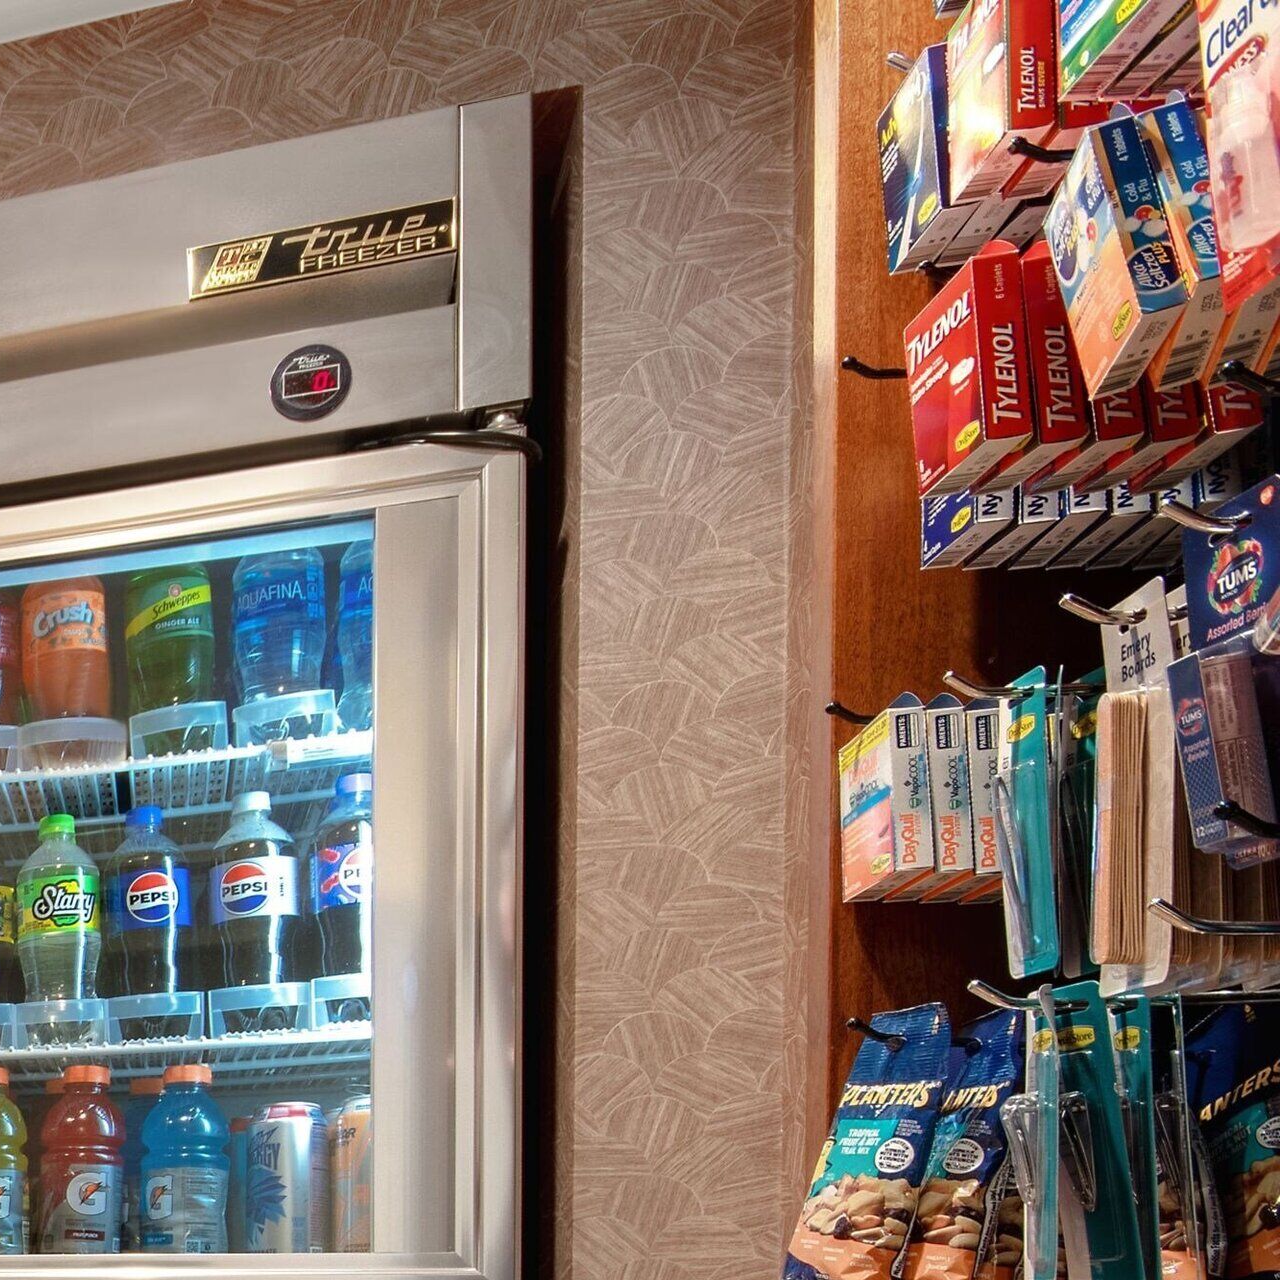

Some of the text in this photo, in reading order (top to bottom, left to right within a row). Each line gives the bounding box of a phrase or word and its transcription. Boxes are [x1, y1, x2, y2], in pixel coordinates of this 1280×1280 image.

[1018, 46, 1035, 113] TYLENOL
[300, 236, 437, 274] FREEZER
[907, 289, 971, 376] TYLENOL
[992, 323, 1022, 424] TYLENOL
[1044, 325, 1077, 429] TYLENOL
[1217, 562, 1259, 595] TUMS
[32, 602, 94, 638] Crush
[151, 590, 201, 618] Schweppes
[155, 617, 202, 630] GINGER ALE
[1205, 613, 1245, 642] Assorted
[1121, 632, 1151, 663] Emery
[899, 811, 916, 864] DayQuil
[939, 814, 957, 866] DayQuil
[979, 816, 996, 868] DayQuil
[222, 881, 268, 898] PEPSI
[839, 1084, 929, 1109] PLANTERS
